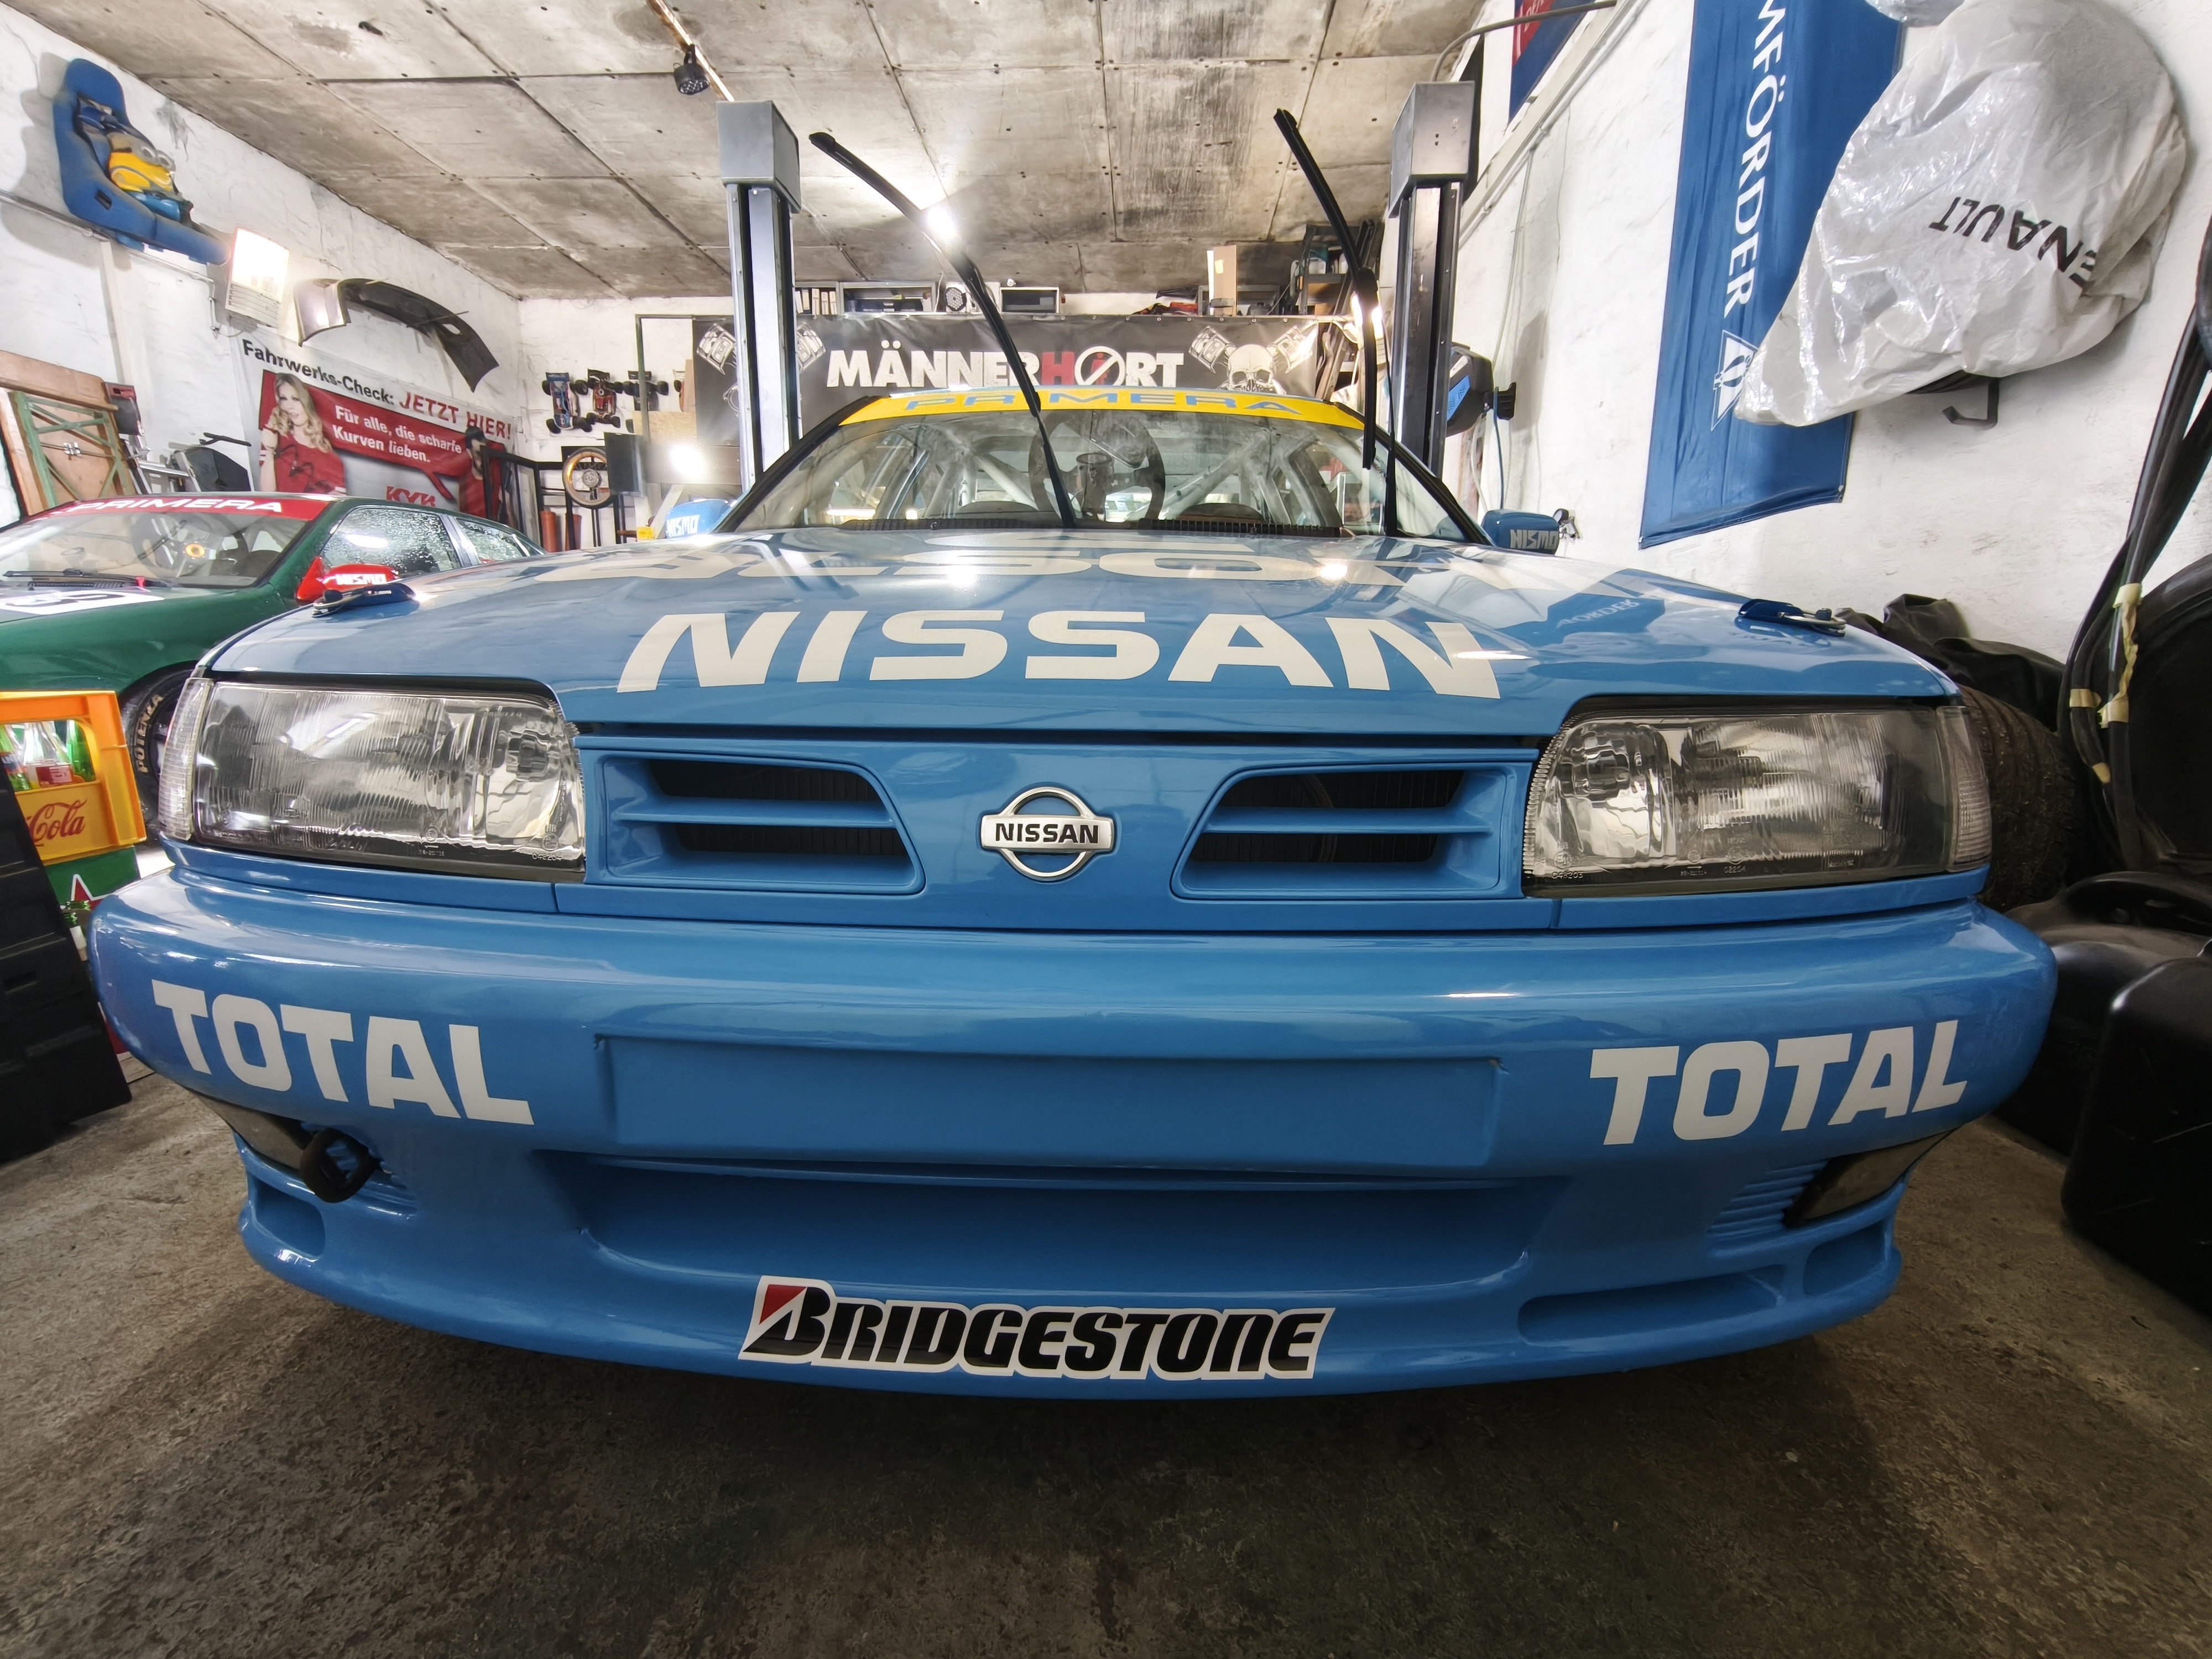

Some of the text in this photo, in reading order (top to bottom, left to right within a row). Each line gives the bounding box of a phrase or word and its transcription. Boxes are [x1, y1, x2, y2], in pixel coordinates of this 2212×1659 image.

[242, 339, 512, 440] Fahrwerks-Check: JETZT HIER!
[905, 392, 1303, 415] PRMERA
[332, 425, 431, 462] Kurven lieben.
[335, 405, 462, 453] Für alle, die scharfe
[65, 498, 282, 513] PRIMERA
[666, 515, 700, 538] NISMO
[1510, 529, 1559, 549] NISMO
[335, 573, 387, 585] NISMO
[616, 610, 1500, 698] NISSAN
[134, 695, 164, 773] POTENZA
[995, 823, 1098, 844] NISSAN
[152, 979, 534, 1125] TOTAL
[1590, 1020, 1967, 1145] TOTAL
[742, 1283, 1327, 1374] BRIDGESTONE
